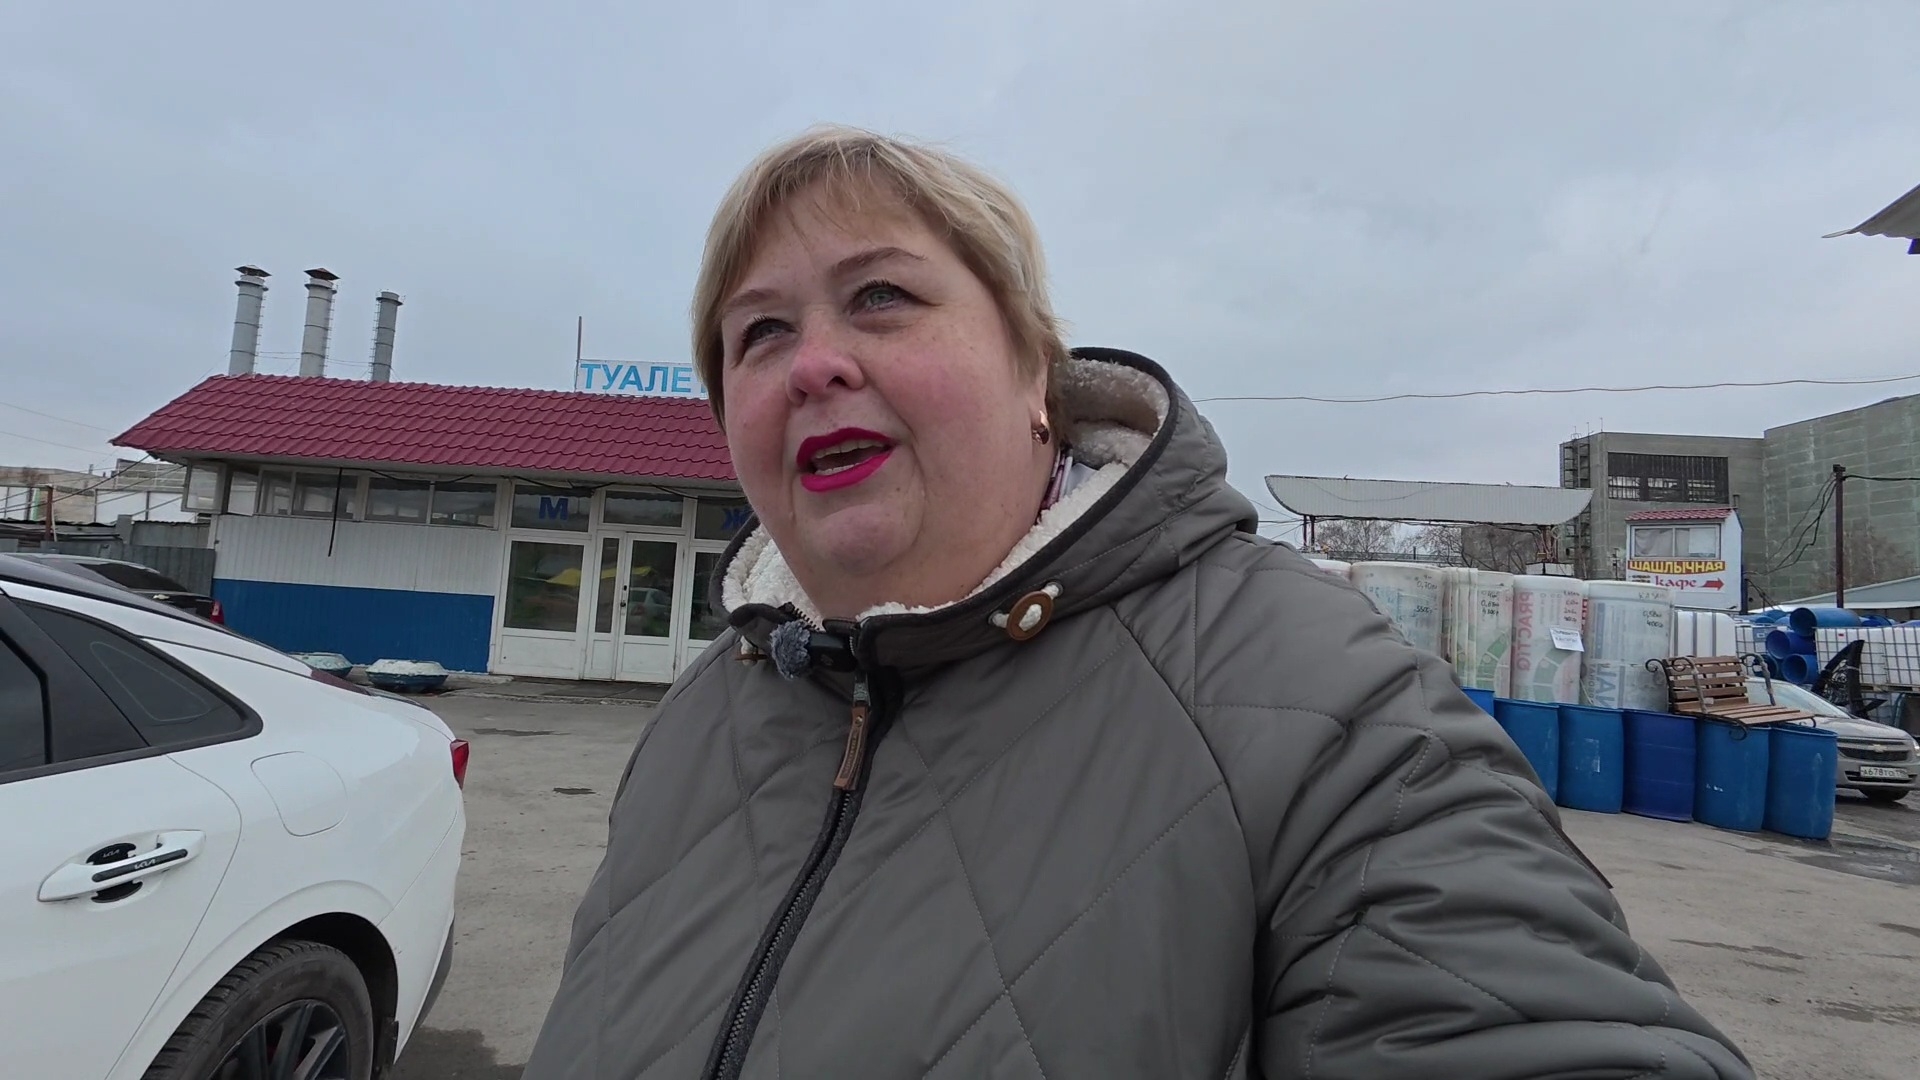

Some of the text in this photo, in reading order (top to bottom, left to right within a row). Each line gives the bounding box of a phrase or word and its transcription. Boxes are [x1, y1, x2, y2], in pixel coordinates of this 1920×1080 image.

[580, 363, 709, 393] ТУАЛЕ
[538, 496, 569, 521] М
[1629, 561, 1723, 574] ШАШЛЫЧНАЯ
